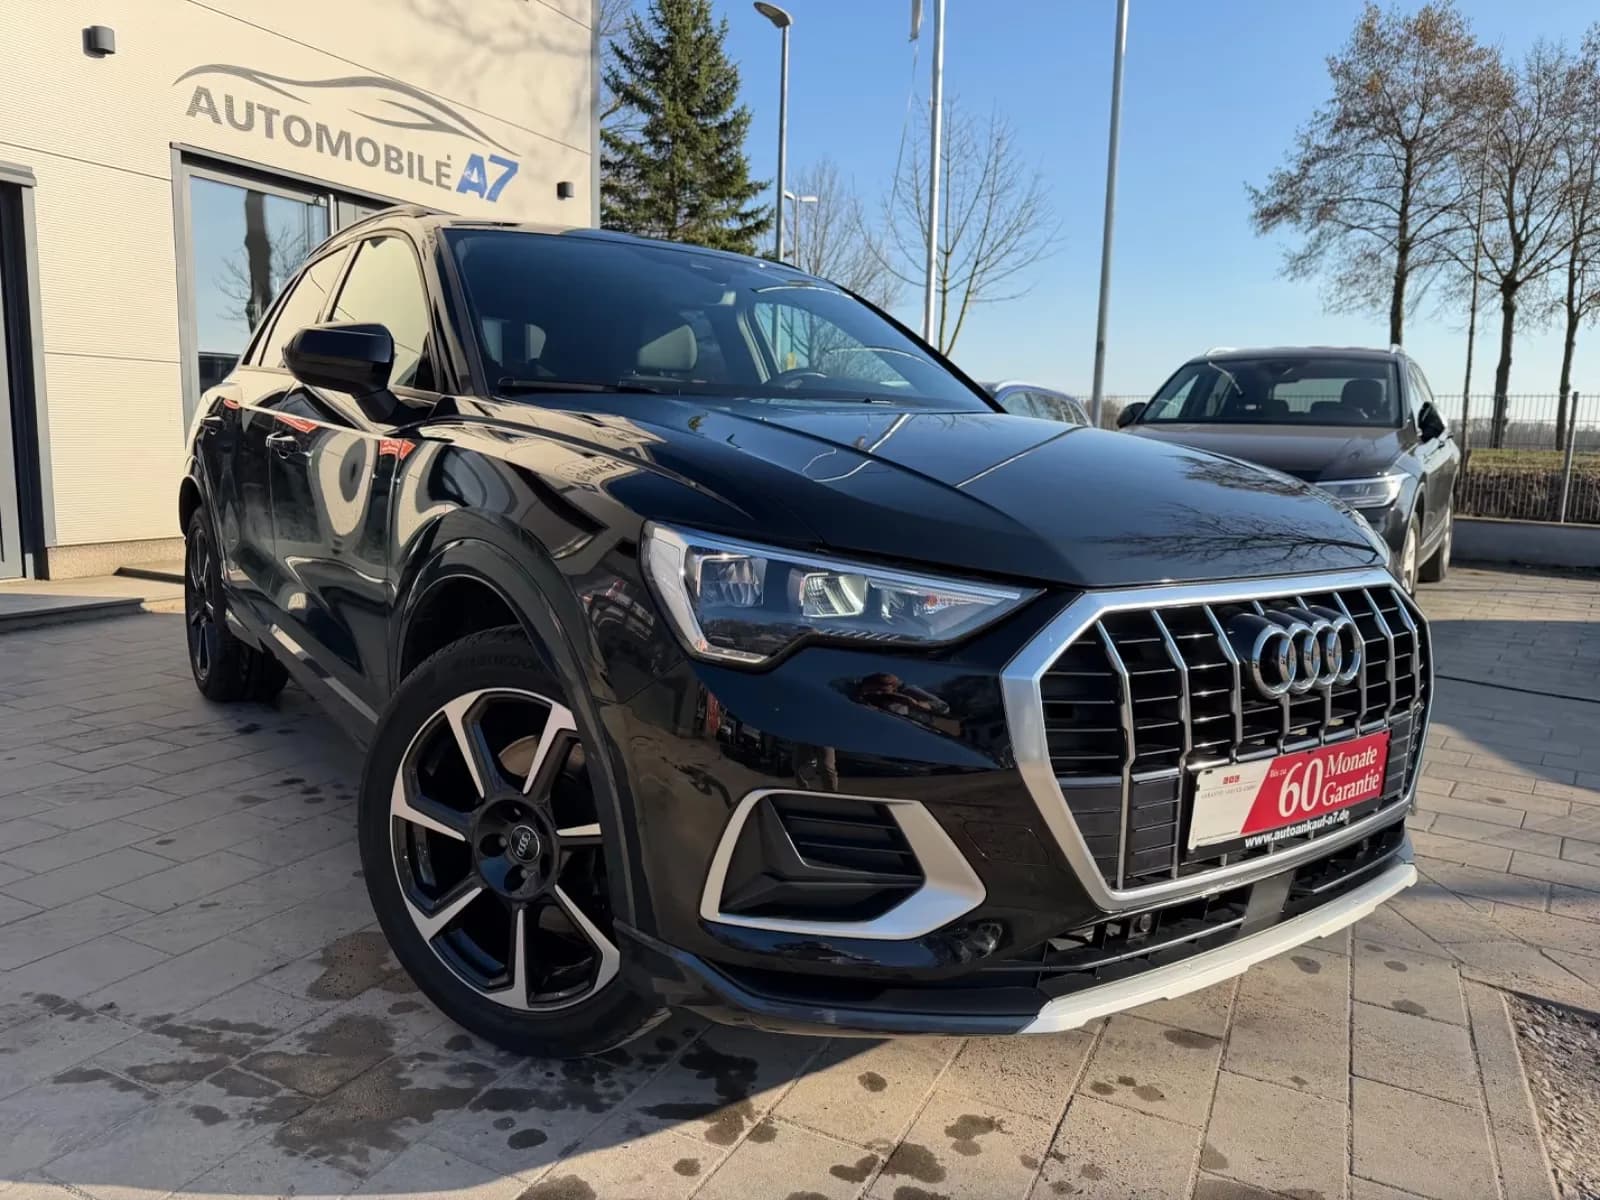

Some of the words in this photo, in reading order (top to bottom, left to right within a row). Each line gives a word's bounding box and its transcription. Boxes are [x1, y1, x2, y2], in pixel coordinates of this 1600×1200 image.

[456, 153, 519, 202] A7
[1279, 758, 1323, 818] 60
[1324, 745, 1378, 778] Monate
[1245, 808, 1350, 848] www.autoankauf-a7.de
